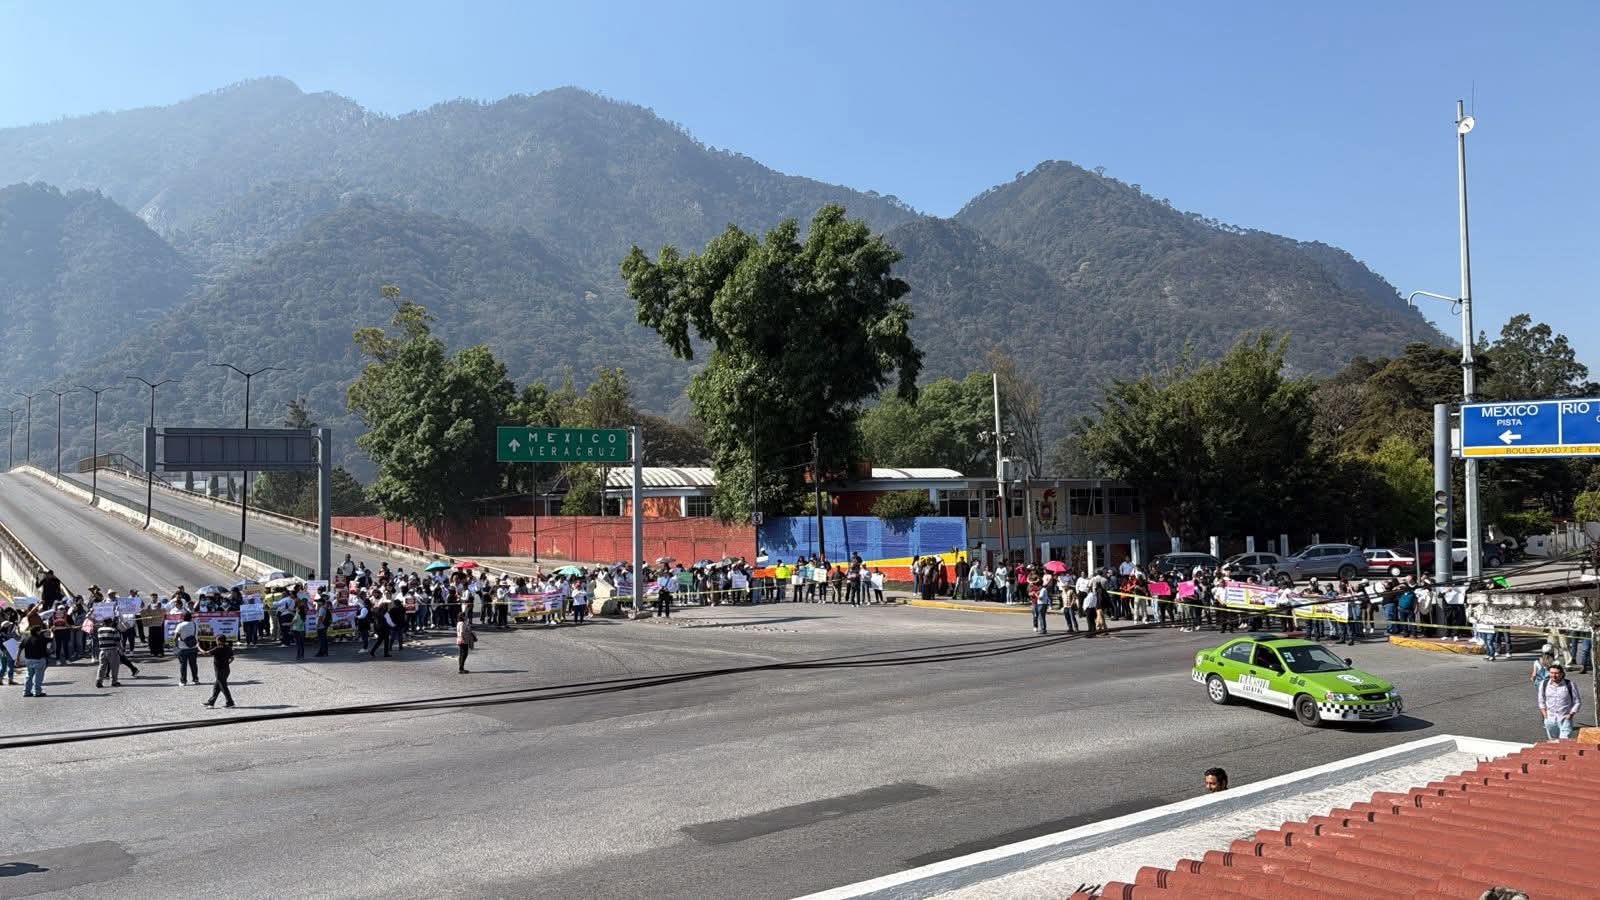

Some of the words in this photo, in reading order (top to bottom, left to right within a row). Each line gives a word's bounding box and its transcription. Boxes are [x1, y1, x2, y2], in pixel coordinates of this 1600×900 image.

[1481, 405, 1538, 417] MEXICO
[1562, 402, 1590, 414] RIO
[1496, 418, 1523, 427] PISTA
[528, 432, 616, 444] MEXICO
[528, 446, 616, 457] VERACRUZ
[1506, 447, 1562, 455] BOULEVARD
[1571, 446, 1582, 454] DE
